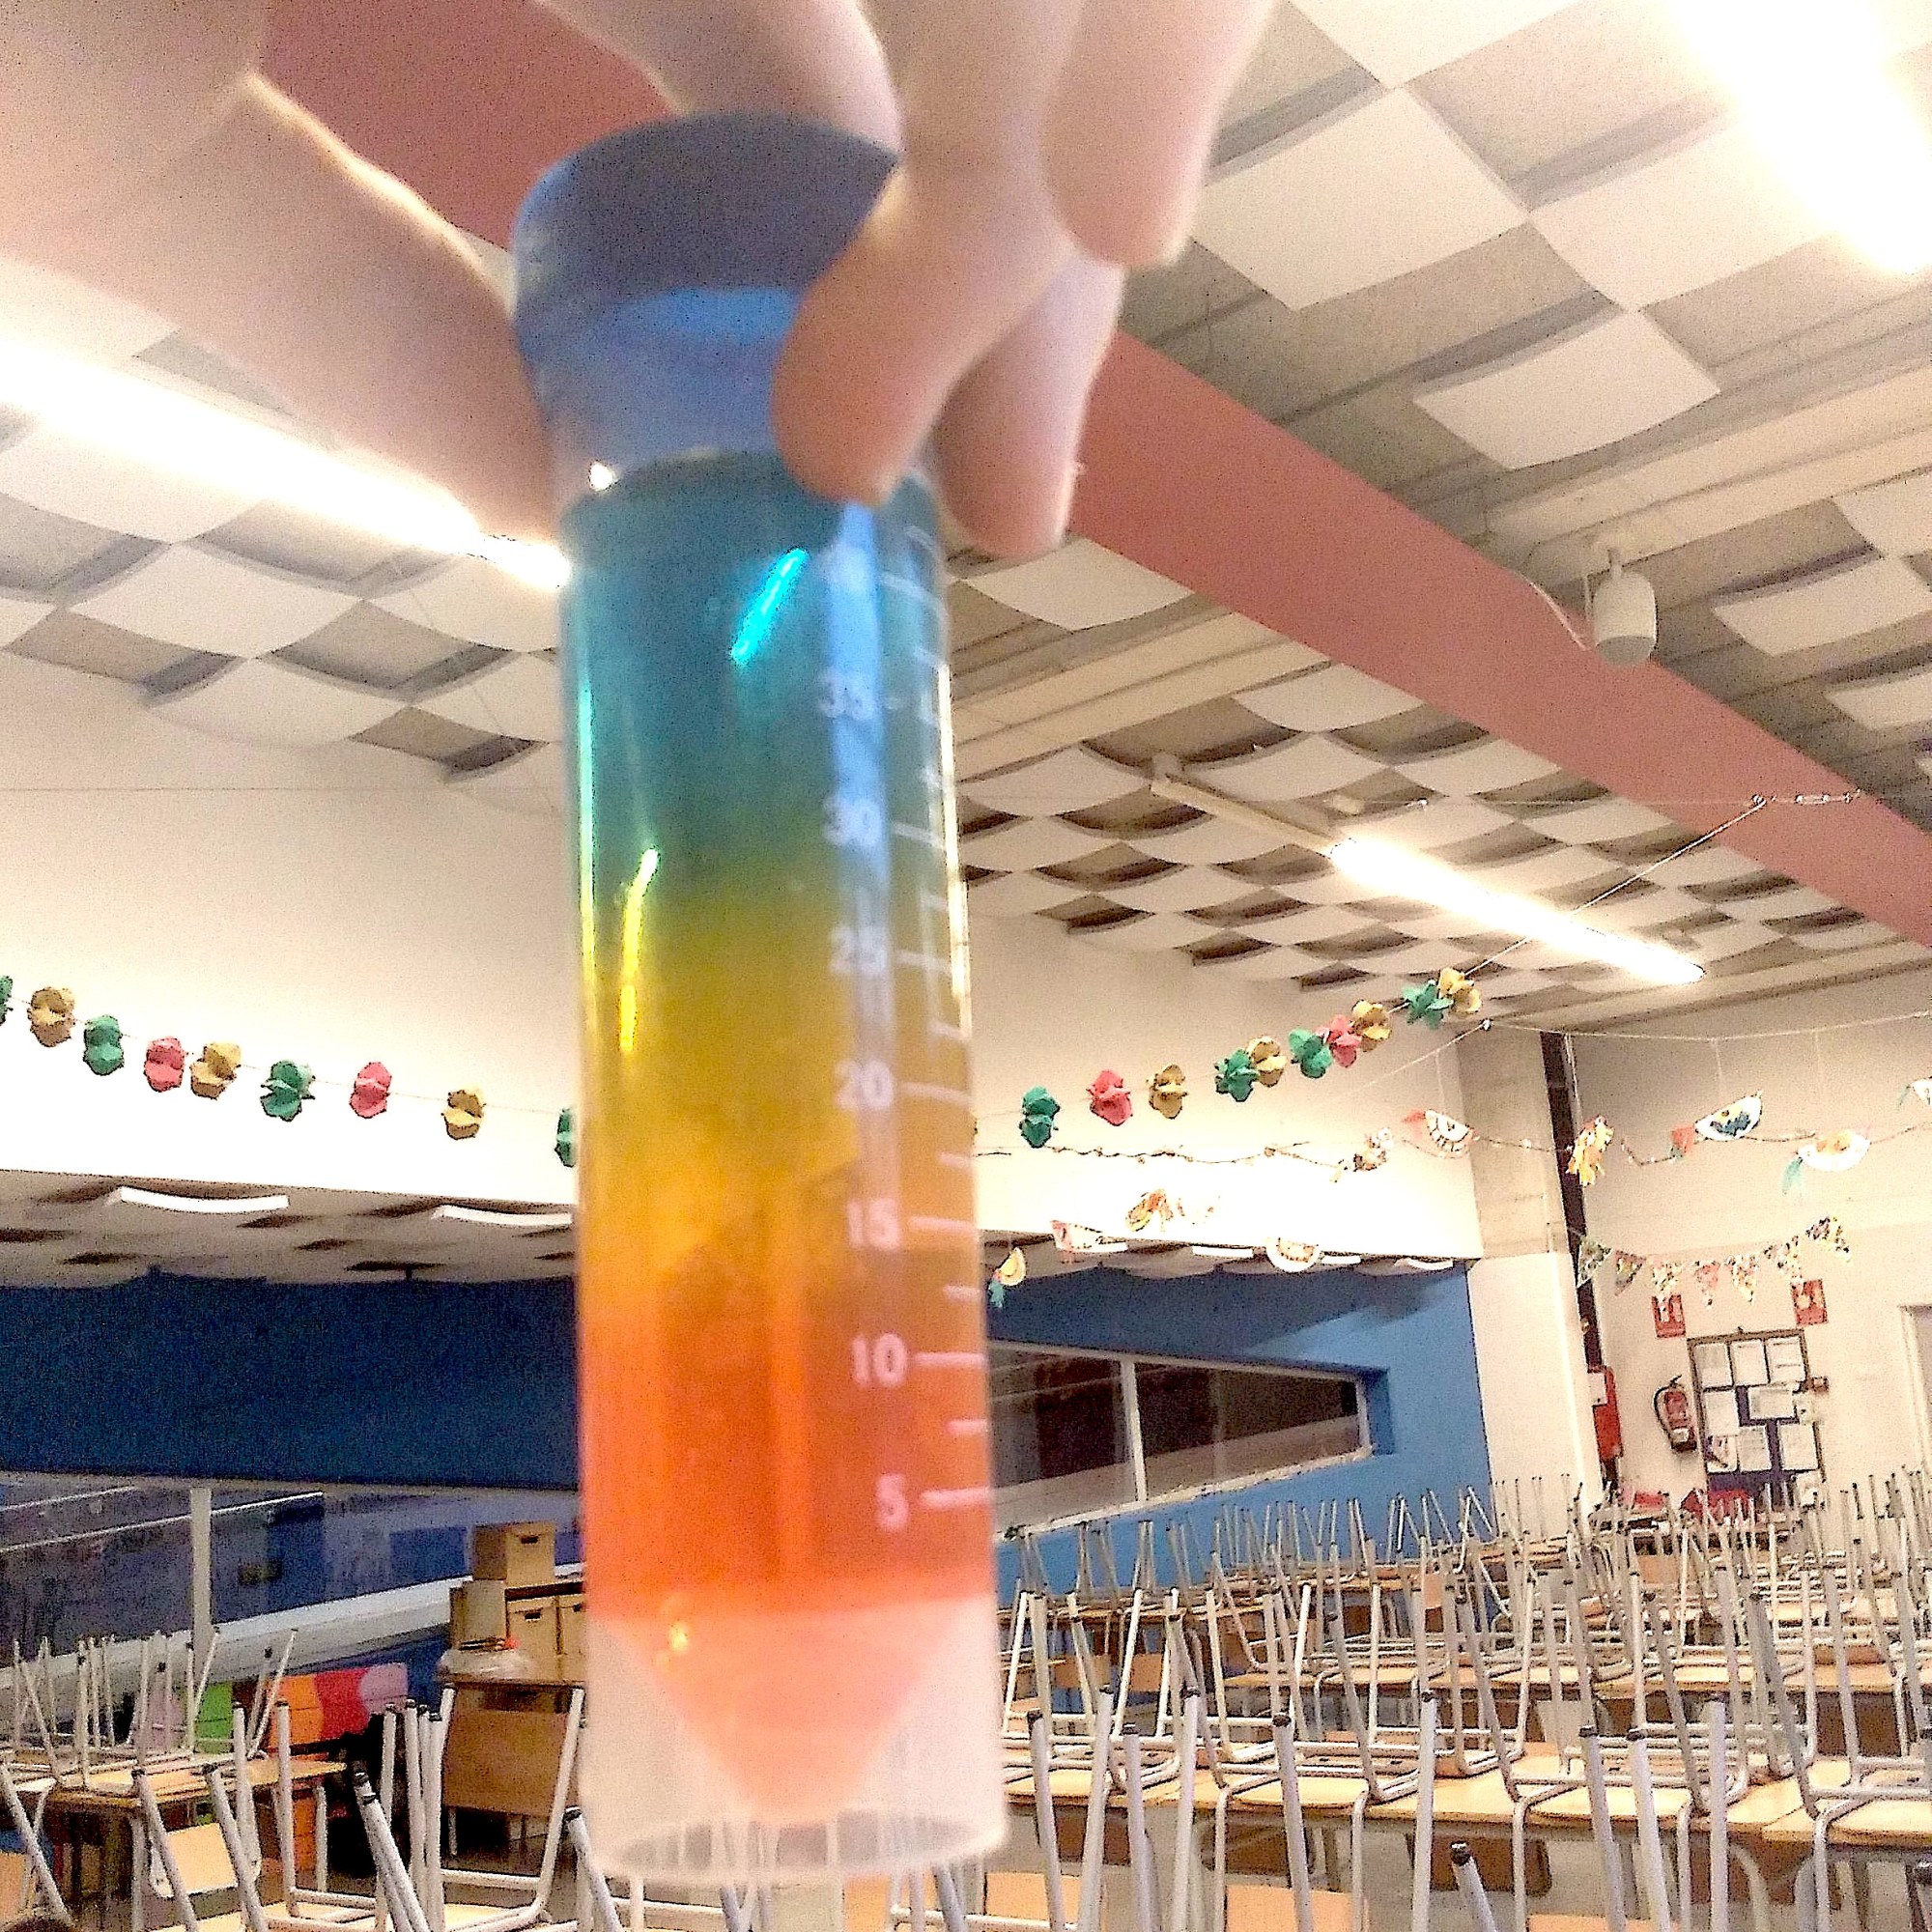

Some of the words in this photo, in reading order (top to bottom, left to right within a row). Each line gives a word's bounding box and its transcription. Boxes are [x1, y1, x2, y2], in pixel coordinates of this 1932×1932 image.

[824, 796, 882, 847] 30
[831, 923, 887, 973] 25
[837, 1062, 895, 1112] 20
[846, 1198, 901, 1250] 15
[852, 1333, 907, 1387] 10
[877, 1472, 909, 1531] 5
